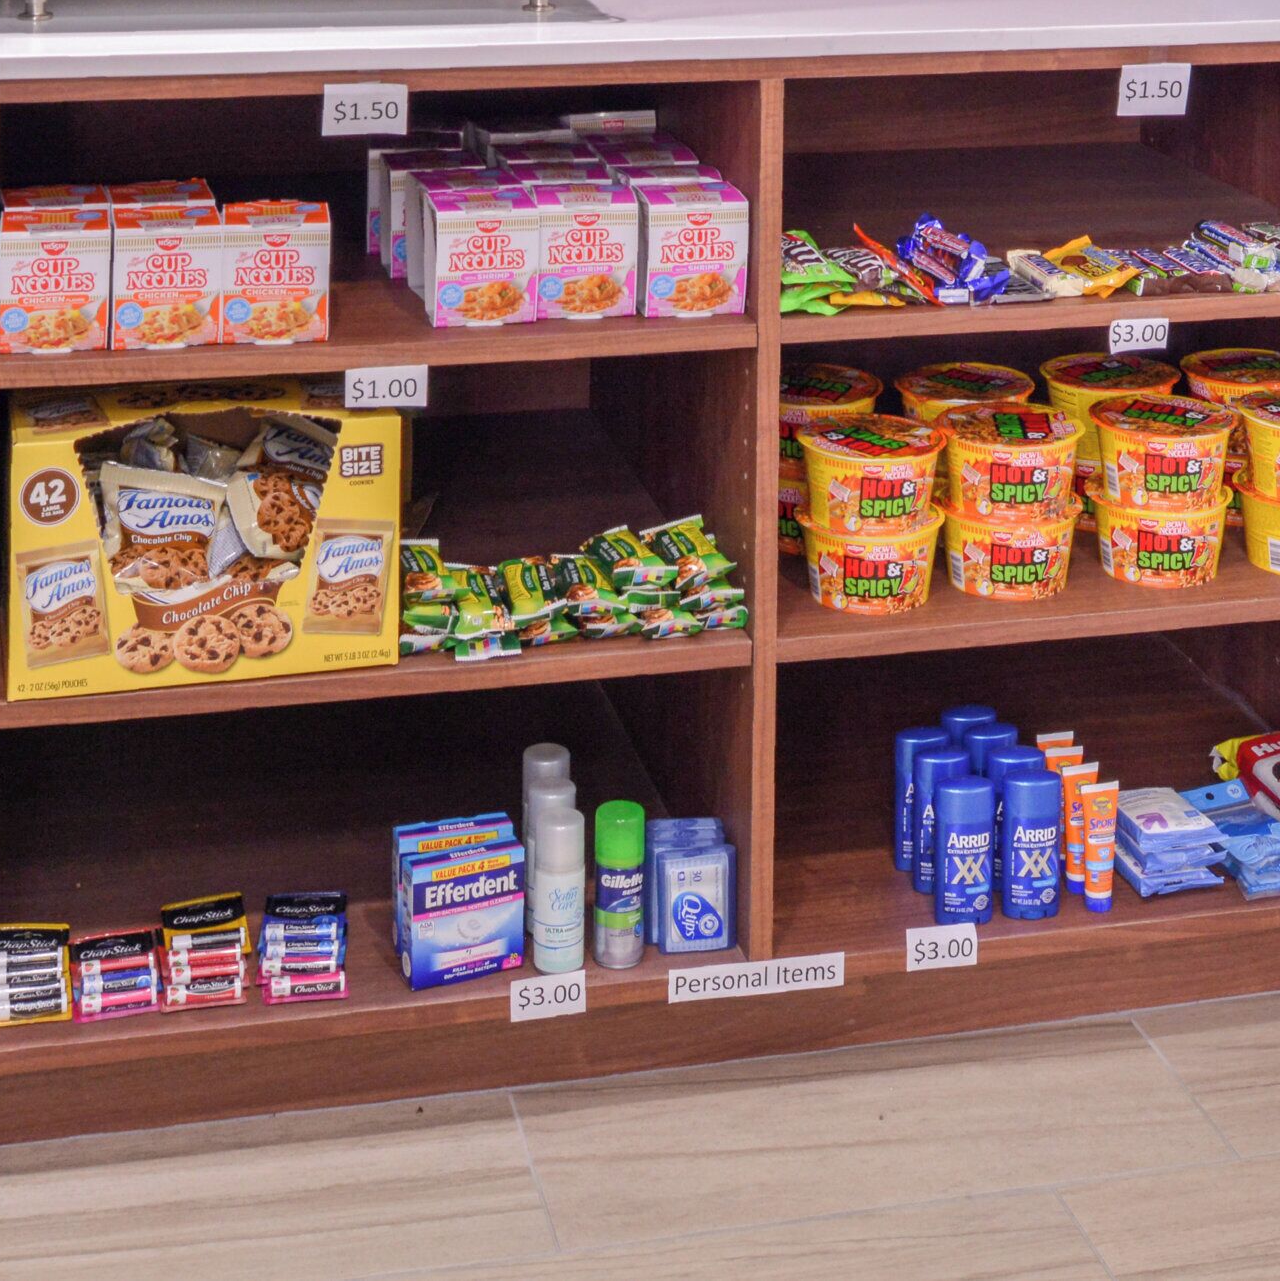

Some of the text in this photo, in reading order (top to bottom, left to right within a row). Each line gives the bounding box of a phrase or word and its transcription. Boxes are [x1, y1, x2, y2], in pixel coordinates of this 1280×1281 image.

[1124, 79, 1184, 102] $1.50
[333, 100, 399, 124] $1.50
[466, 234, 511, 254] CUP
[565, 228, 610, 246] CUP
[146, 253, 193, 273] CUP
[253, 249, 300, 269] CUP
[448, 249, 525, 272] NOODLES
[547, 243, 624, 265] NOODLES
[31, 257, 80, 277] CUP
[234, 265, 316, 287] NOODLES
[10, 272, 95, 296] NOODLES
[126, 268, 208, 291] NOODLES
[1111, 323, 1167, 347] $3.00
[350, 377, 418, 402] $1.00
[341, 445, 382, 462] BITE
[341, 460, 382, 476] SIZE
[991, 464, 1048, 483] HOT &
[1145, 455, 1187, 474] HOT
[28, 479, 67, 507] 42
[861, 477, 917, 498] HOT &
[991, 483, 1046, 503] SPICY
[1145, 473, 1201, 493] SPICY
[117, 488, 215, 513] Famous
[135, 510, 216, 529] Amos
[130, 532, 193, 544] Chocolate Chip
[317, 538, 383, 565] Famous
[991, 545, 1032, 564] HOT
[1137, 550, 1195, 570] SPICY
[331, 555, 383, 579] Amos
[845, 557, 903, 578] HOT &
[991, 563, 1046, 583] SPICY
[25, 559, 92, 600] Famous
[844, 576, 901, 597] SPICY
[41, 576, 96, 609] Amos
[161, 581, 252, 626] Chocolate Chip
[323, 654, 334, 663] NET
[61, 677, 88, 688] POUCHES
[438, 821, 475, 832] Efferdent
[1014, 825, 1057, 843] ARRID
[421, 840, 444, 851] VALUE
[444, 838, 463, 848] PACK
[947, 831, 990, 849] ARRID
[435, 868, 456, 879] VALUE
[457, 864, 476, 874] PACK
[425, 870, 518, 909] Efferdent
[173, 909, 233, 926] ChapStick
[275, 904, 336, 914] ChapStick
[79, 945, 143, 961] ChapStick
[914, 936, 974, 966] $3.00
[675, 963, 837, 996] Personal Items
[518, 982, 582, 1011] $3.00
